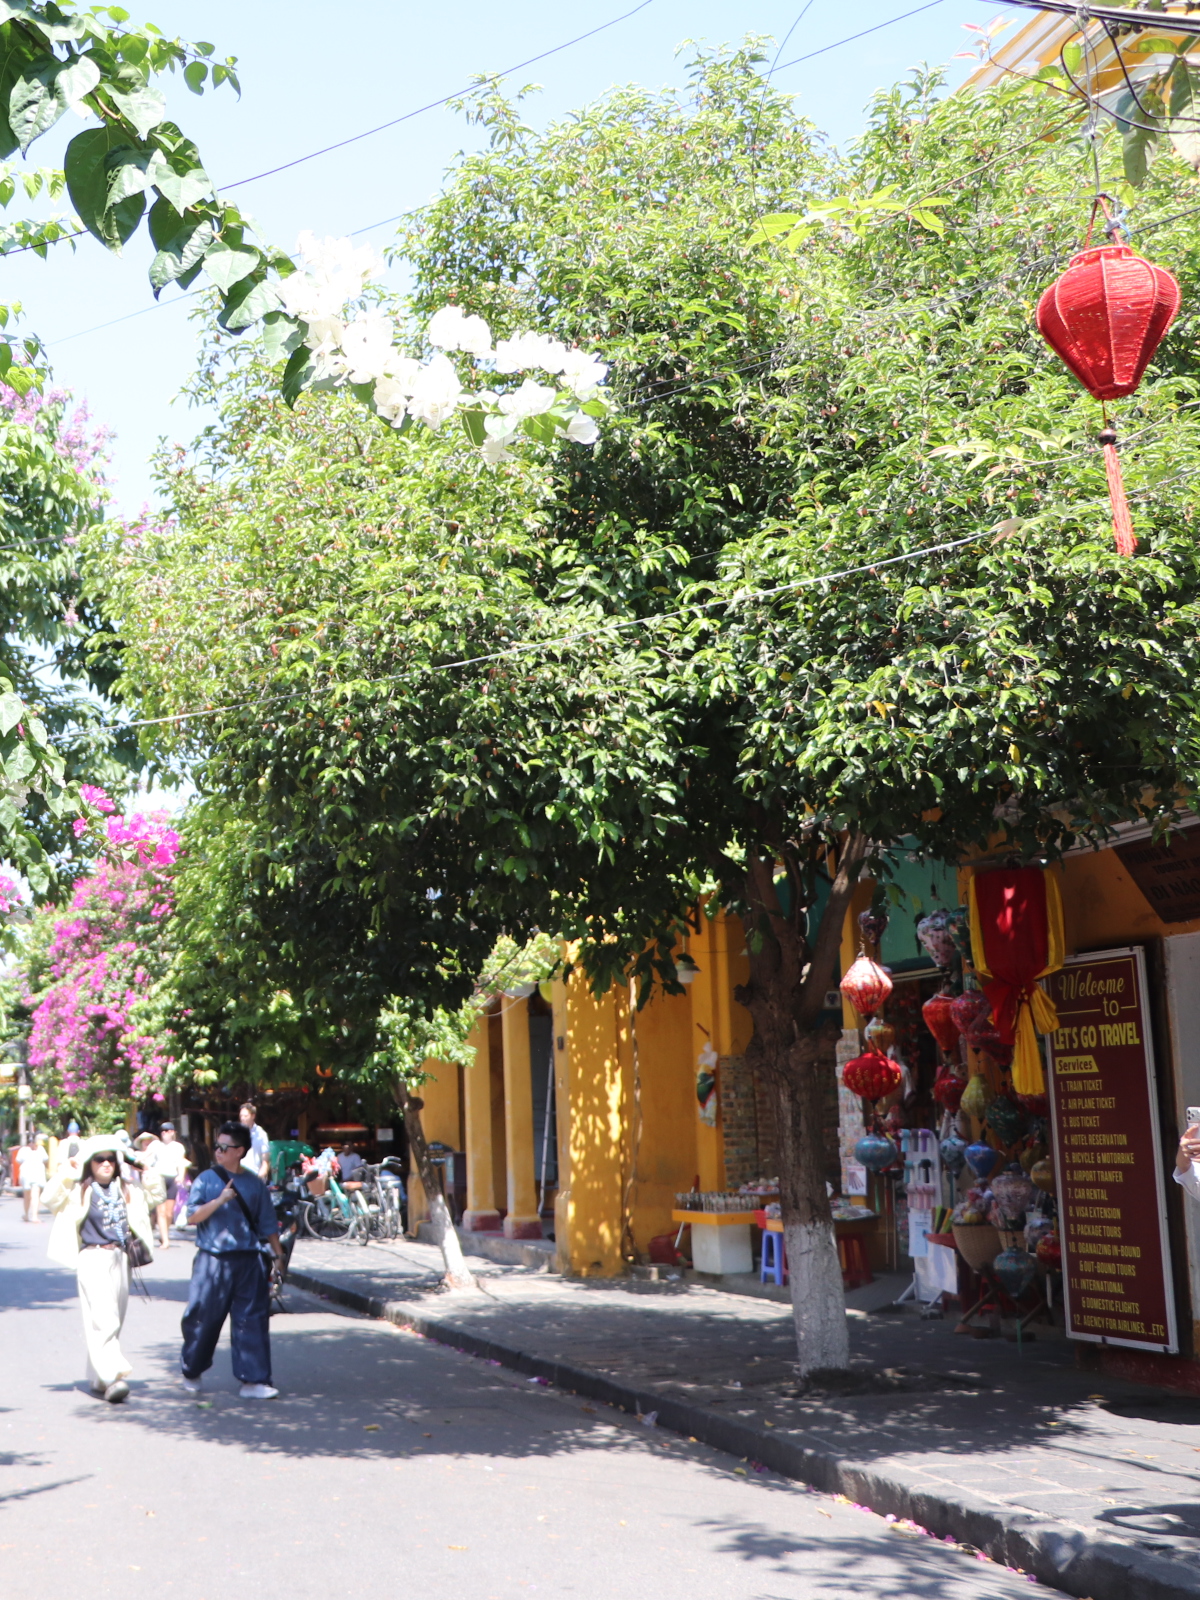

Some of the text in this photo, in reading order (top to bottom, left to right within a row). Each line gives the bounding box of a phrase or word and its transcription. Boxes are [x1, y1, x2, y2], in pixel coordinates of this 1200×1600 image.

[1058, 970, 1125, 1000] Welcome
[1103, 997, 1119, 1016] to
[1053, 1022, 1140, 1050] LET'S GO TRAVEL
[1058, 1058, 1093, 1072] Services
[1066, 1080, 1083, 1092] TRAIN
[1083, 1079, 1103, 1091] TICKET
[1096, 1097, 1116, 1109] TICKET
[1069, 1116, 1080, 1127] BUS
[1080, 1115, 1100, 1127] TICKET
[1070, 1134, 1088, 1145] HOTEL
[1088, 1134, 1128, 1146] RESERVATION
[1072, 1152, 1095, 1164] BICYCLE
[1101, 1152, 1135, 1164] MOTORBIKE
[1073, 1170, 1096, 1182] AIRPORT
[1074, 1188, 1085, 1200] CAR
[1086, 1189, 1108, 1200] RENTAL
[1075, 1206, 1089, 1218] VISA
[1089, 1206, 1121, 1219] EXTENSION
[1077, 1224, 1102, 1236] PACKAGE
[1103, 1225, 1122, 1238] TOURS
[1112, 1244, 1141, 1258] IN-BOUND
[1116, 1263, 1136, 1276] TOURS
[1080, 1278, 1125, 1294] INTERNATIONAL
[1086, 1297, 1115, 1312] DOMESTIC
[1115, 1300, 1140, 1315] FLIGHTS
[1083, 1314, 1105, 1329] AGENCY
[1105, 1317, 1117, 1330] FOR
